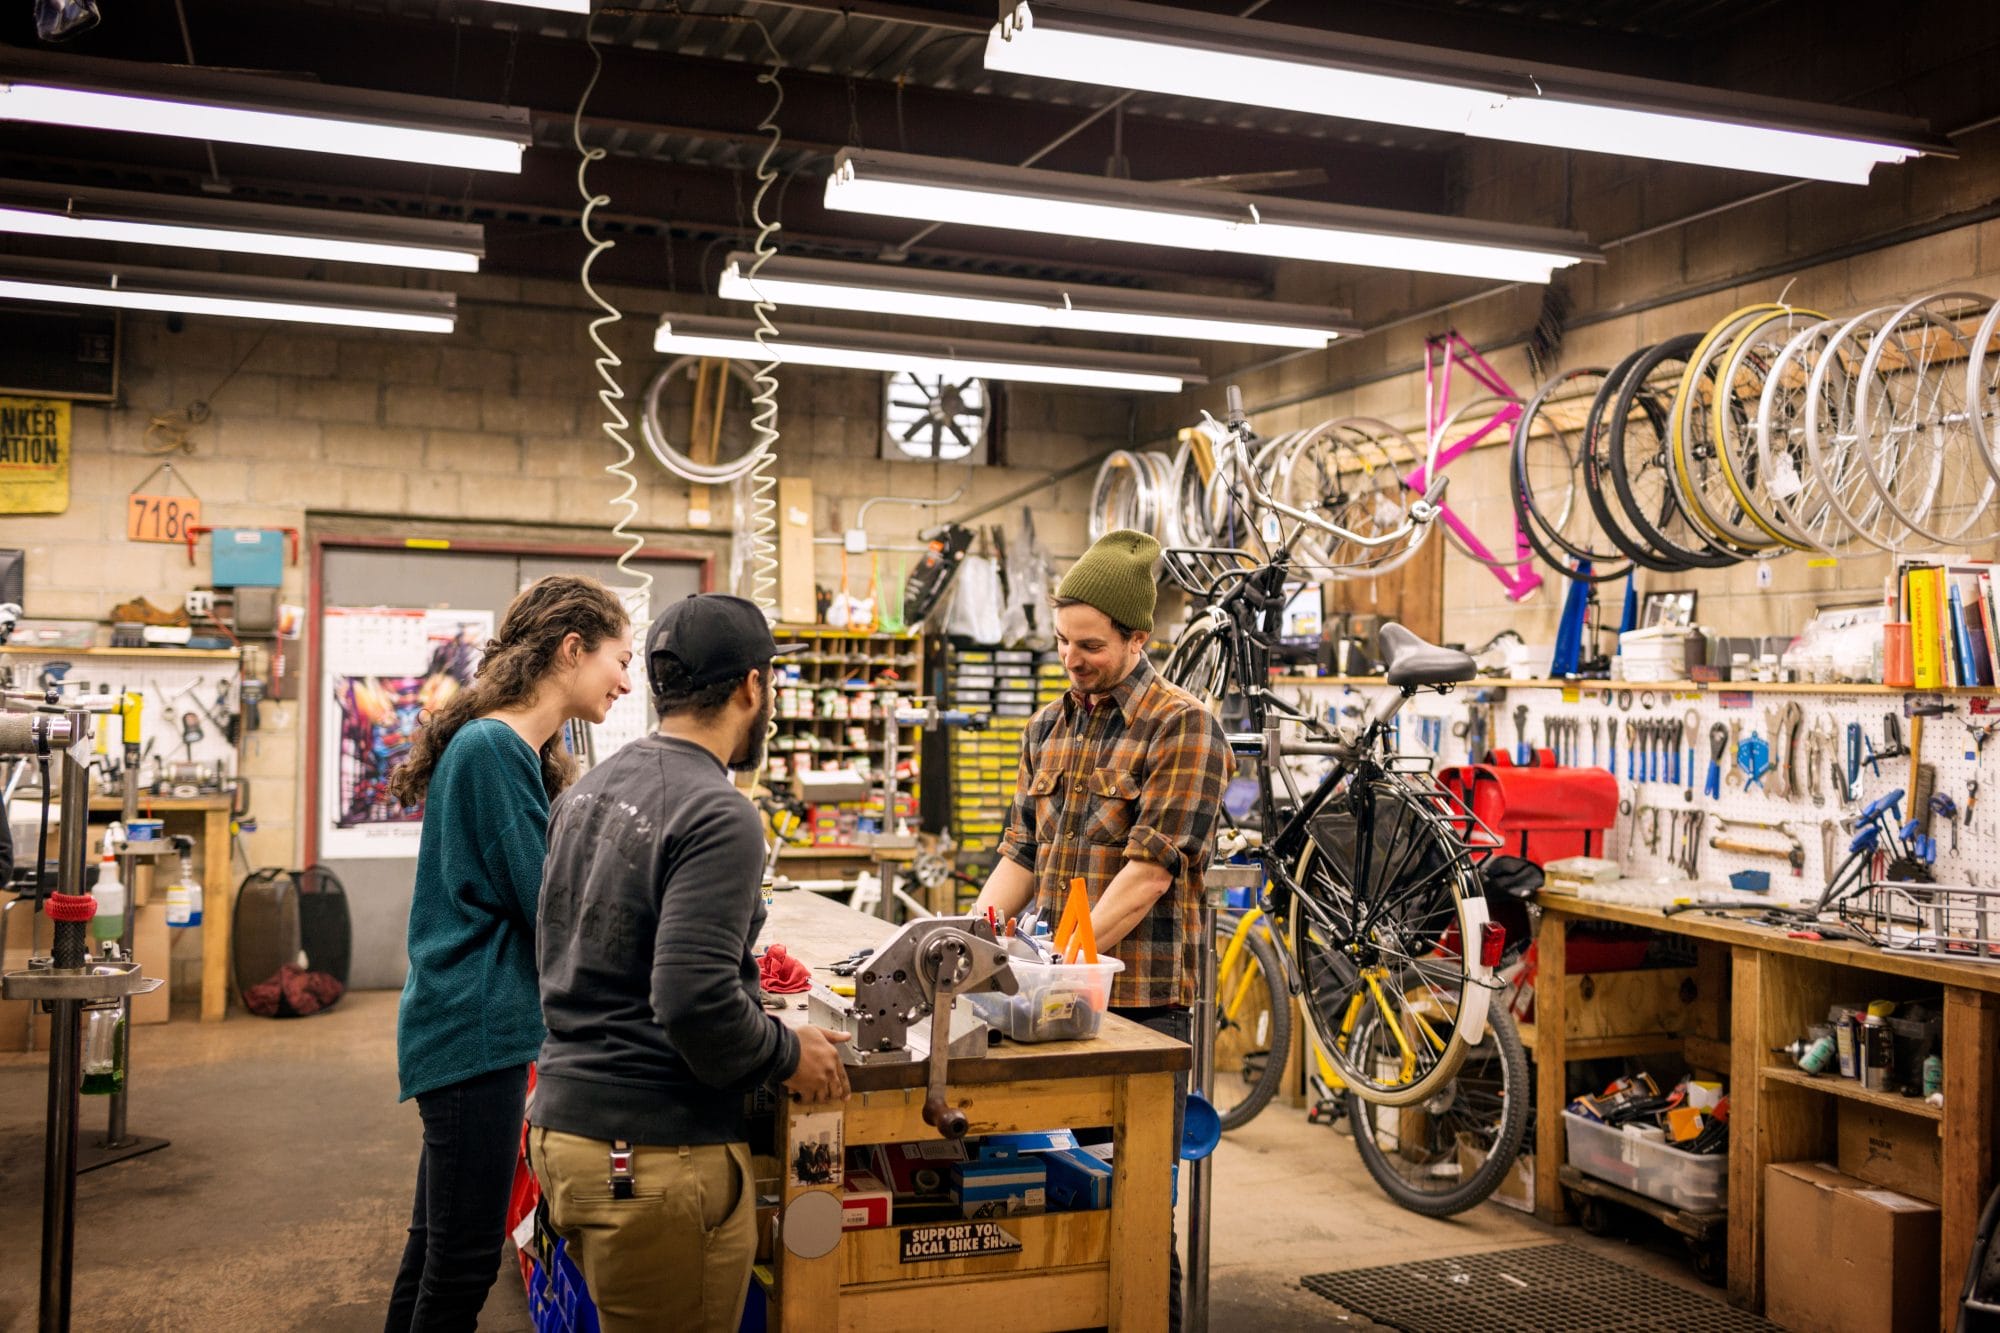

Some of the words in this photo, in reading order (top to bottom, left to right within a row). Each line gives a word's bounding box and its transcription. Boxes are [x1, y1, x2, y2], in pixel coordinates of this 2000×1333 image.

[0, 437, 58, 464] ATION
[912, 1226, 971, 1243] SUPPORT
[975, 1224, 1001, 1237] YOU
[906, 1241, 945, 1256] LOCAL
[949, 1238, 980, 1252] BIKE
[983, 1236, 1013, 1249] SH
